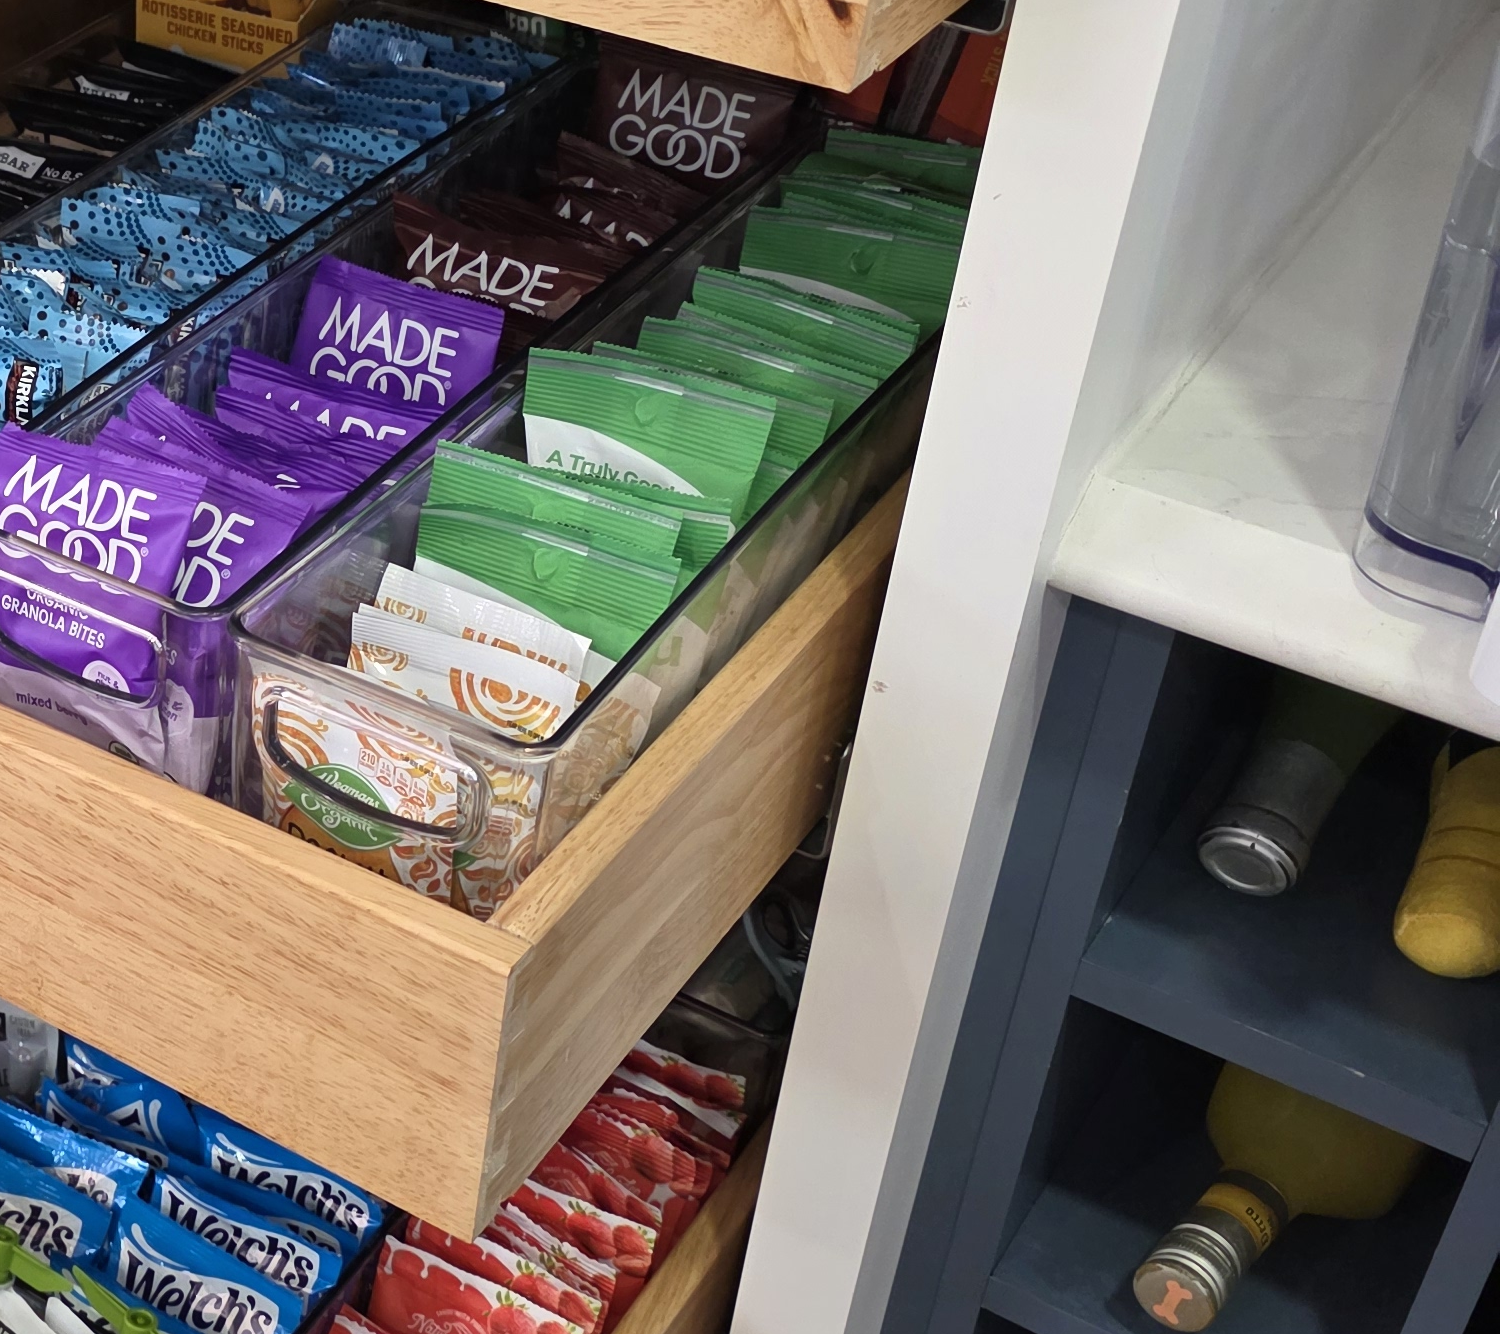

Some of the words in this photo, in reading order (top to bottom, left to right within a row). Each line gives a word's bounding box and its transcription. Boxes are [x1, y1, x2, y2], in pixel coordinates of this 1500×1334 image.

[166, 20, 217, 45] CHICKEN
[221, 30, 264, 55] STICKS
[220, 16, 294, 45] SEASONED
[616, 67, 757, 139] MADE
[41, 166, 59, 179] No
[608, 113, 743, 180] GOOD
[406, 232, 561, 309] MADE
[318, 295, 460, 378] MADE
[545, 449, 563, 466] A
[568, 455, 620, 485] Truly
[2, 454, 158, 544] MADE
[1, 594, 65, 633] GRANOLA
[68, 620, 106, 649] BITES
[16, 692, 53, 710] mixed
[360, 749, 376, 766] 210
[300, 792, 379, 842] Organic
[213, 1154, 370, 1238] Welch's
[165, 1188, 315, 1291] Welch's
